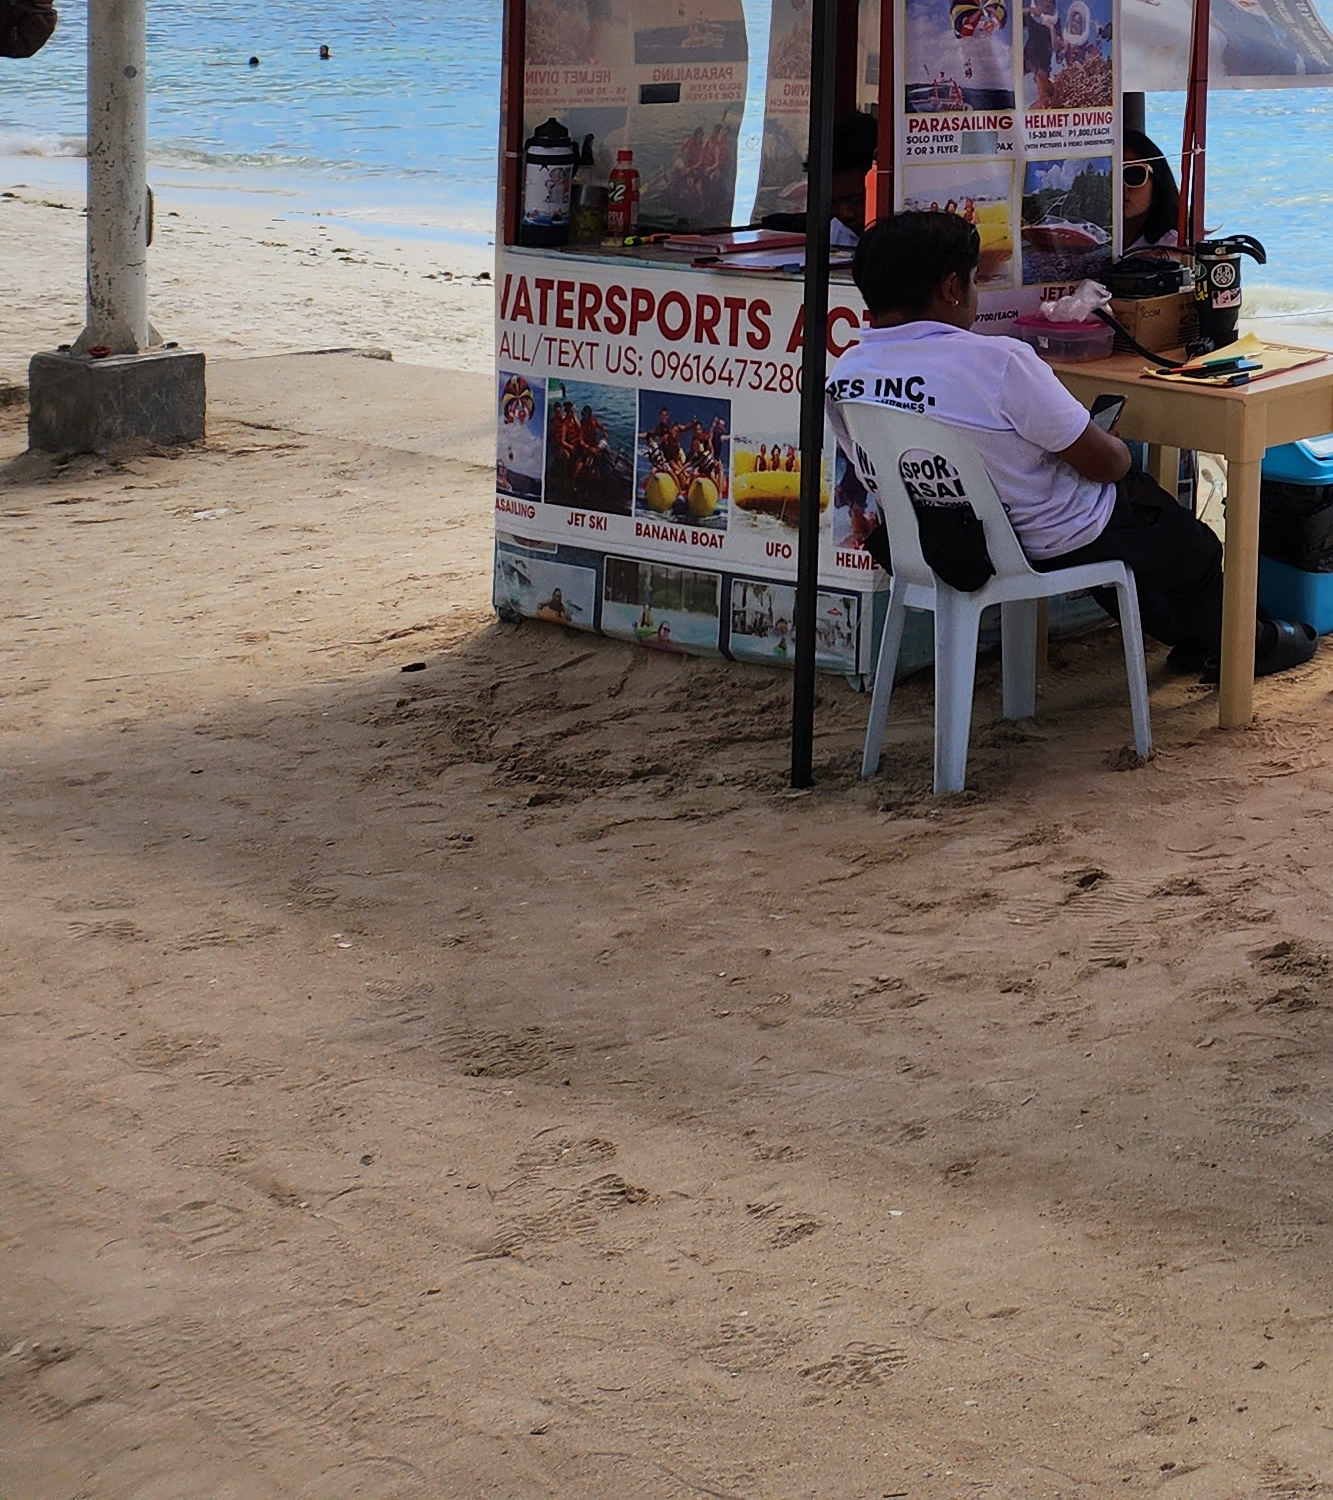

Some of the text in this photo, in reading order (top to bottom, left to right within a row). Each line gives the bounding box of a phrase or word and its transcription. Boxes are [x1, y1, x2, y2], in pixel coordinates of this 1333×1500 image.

[908, 116, 1014, 133] PARASAILING
[1025, 112, 1113, 129] HELMET DIVING
[906, 134, 954, 144] SOLO FLYER
[906, 147, 912, 155] 2
[914, 147, 927, 155] OR
[929, 146, 935, 154] 3
[937, 145, 959, 154] FLYER
[1040, 286, 1066, 301] JET
[500, 330, 600, 371] ALL/TEXT
[607, 344, 643, 377] US:
[874, 376, 936, 406] INC.
[566, 511, 607, 531] JET SKI
[635, 521, 725, 549] BANANA BOAT
[765, 541, 792, 559] UFO
[835, 552, 882, 571] HELME
